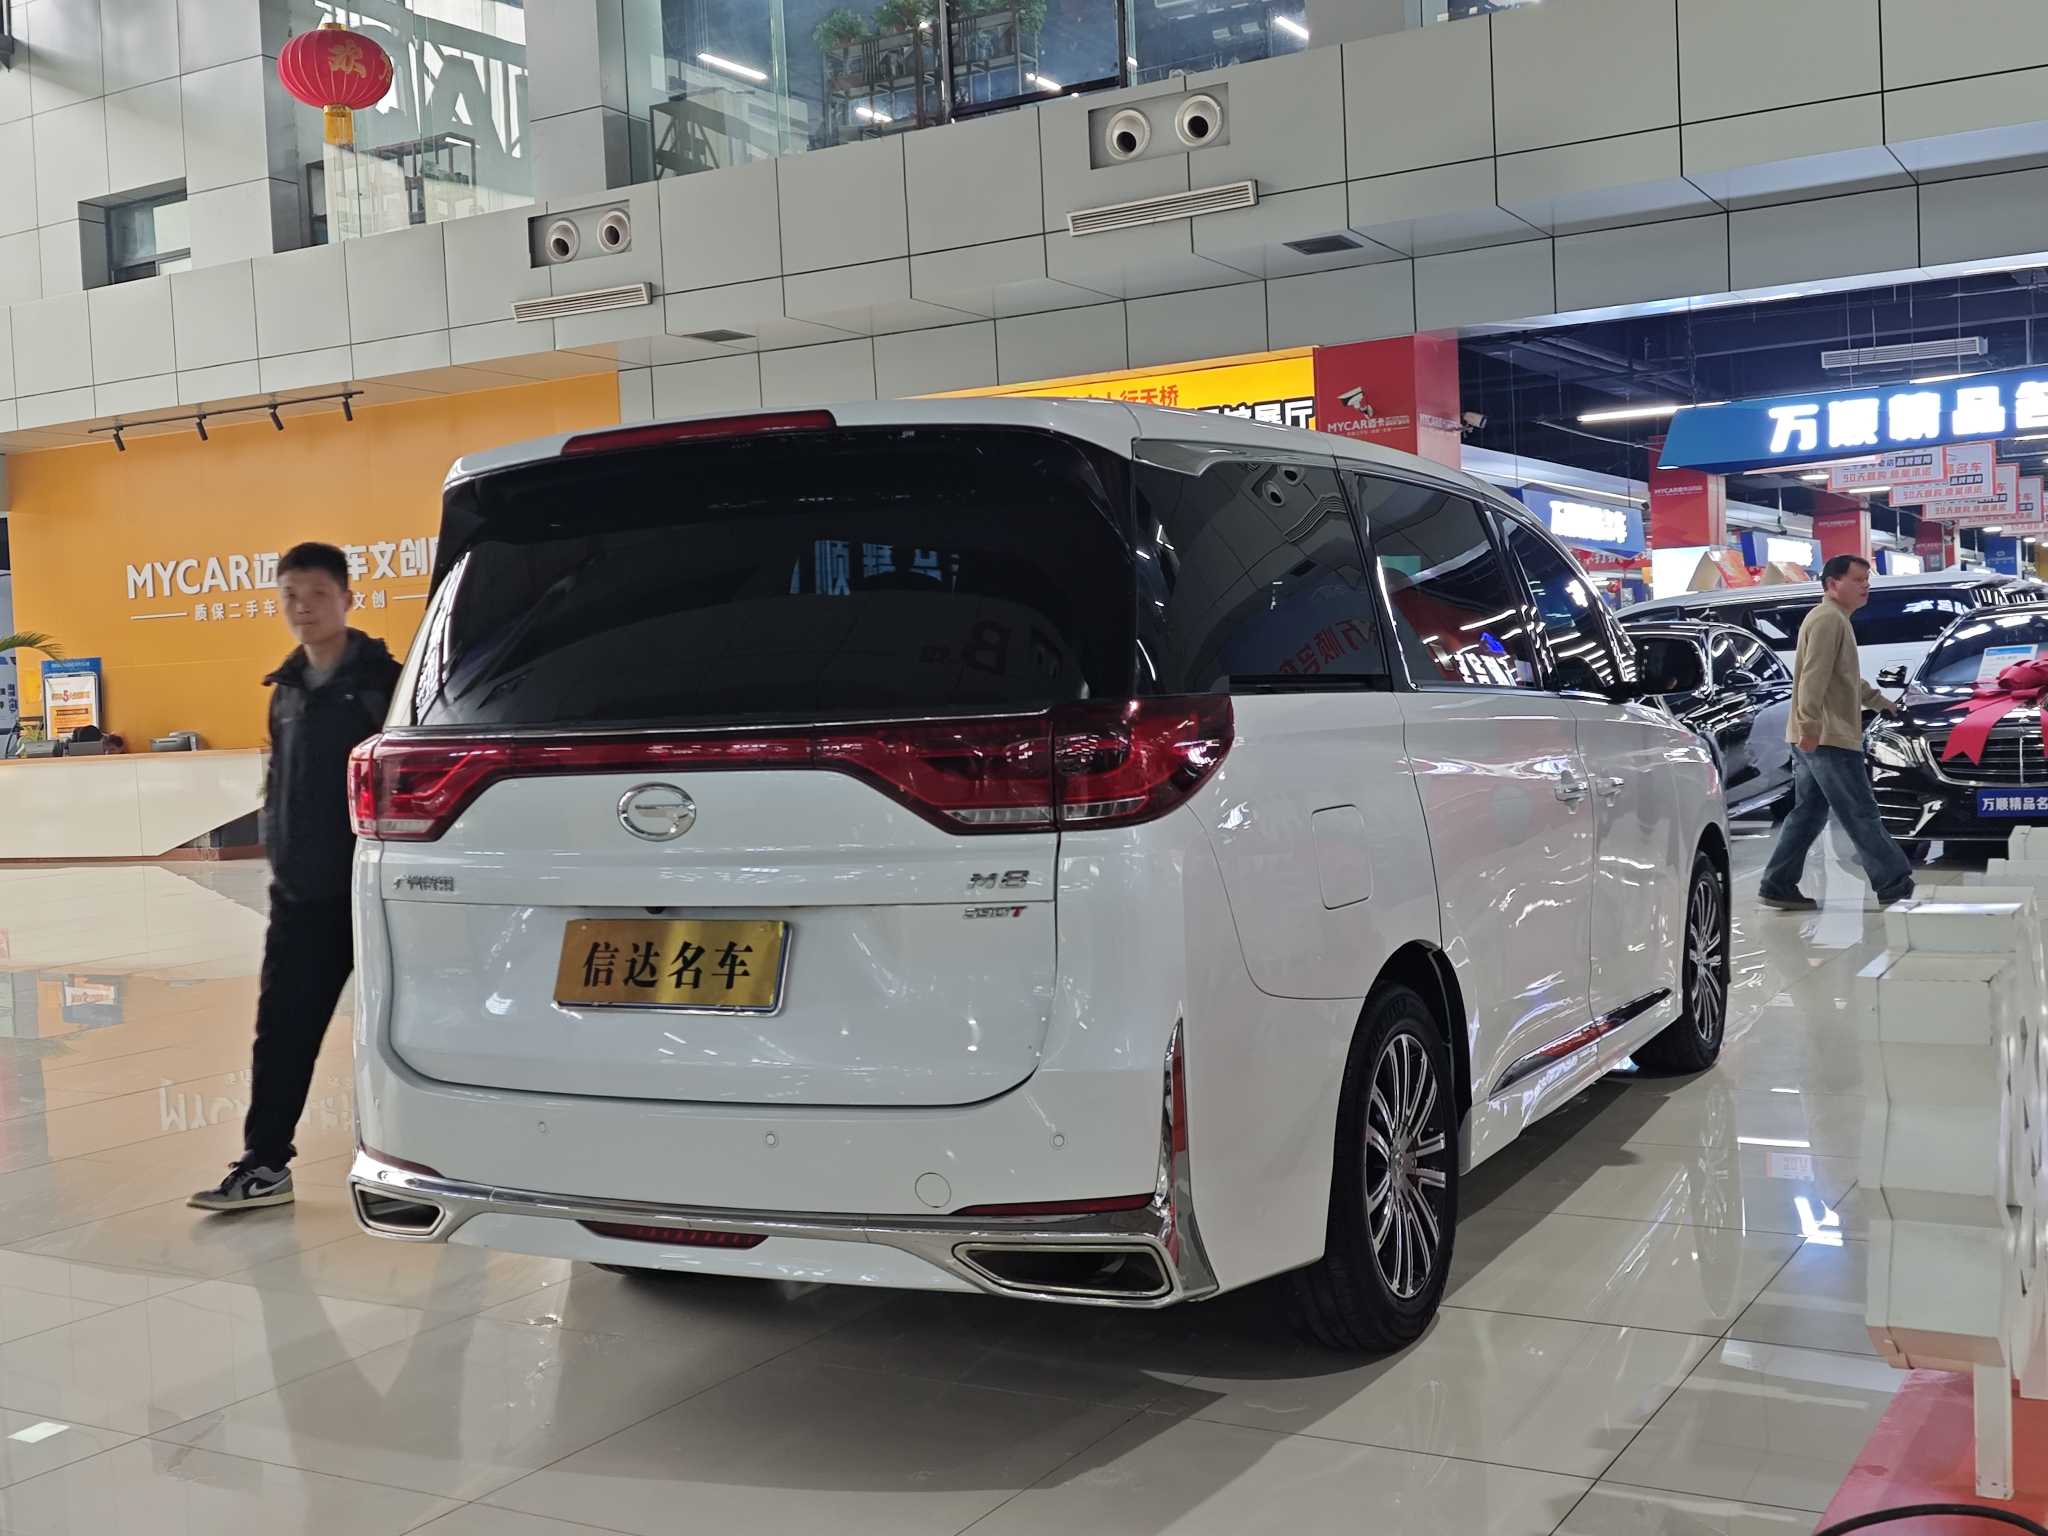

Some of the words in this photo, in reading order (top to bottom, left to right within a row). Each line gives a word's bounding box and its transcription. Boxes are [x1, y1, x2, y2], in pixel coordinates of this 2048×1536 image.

[968, 870, 1029, 888] M8
[583, 940, 753, 990] 信达名车
